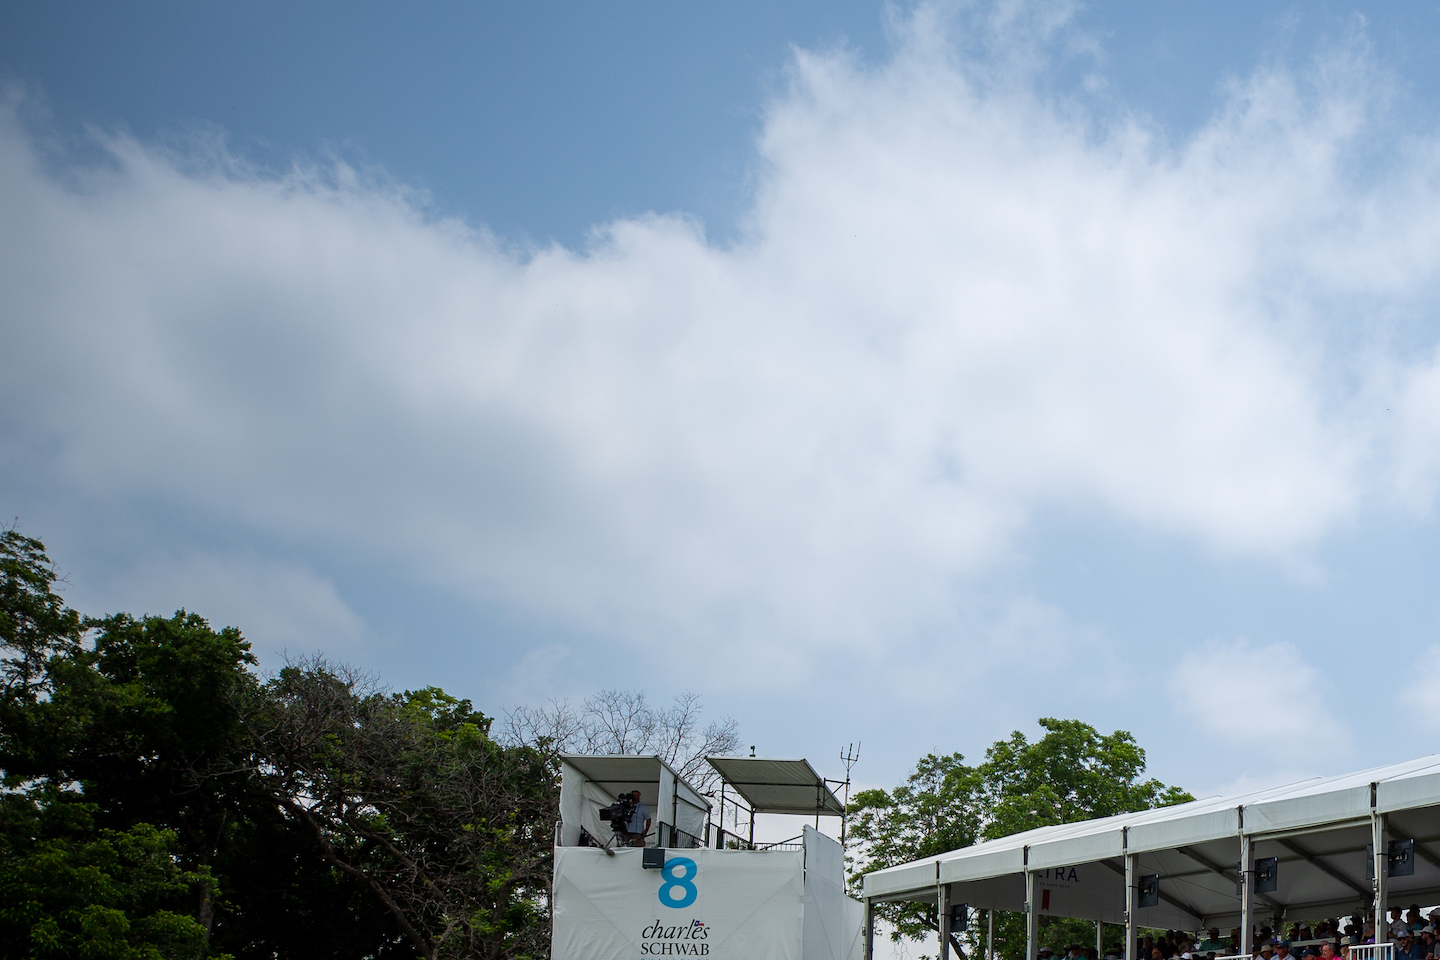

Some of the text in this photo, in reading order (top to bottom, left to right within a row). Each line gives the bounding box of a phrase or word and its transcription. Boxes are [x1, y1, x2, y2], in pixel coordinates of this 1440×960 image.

[658, 857, 697, 909] 8
[642, 919, 710, 939] charles
[641, 942, 709, 955] SCHWAB
